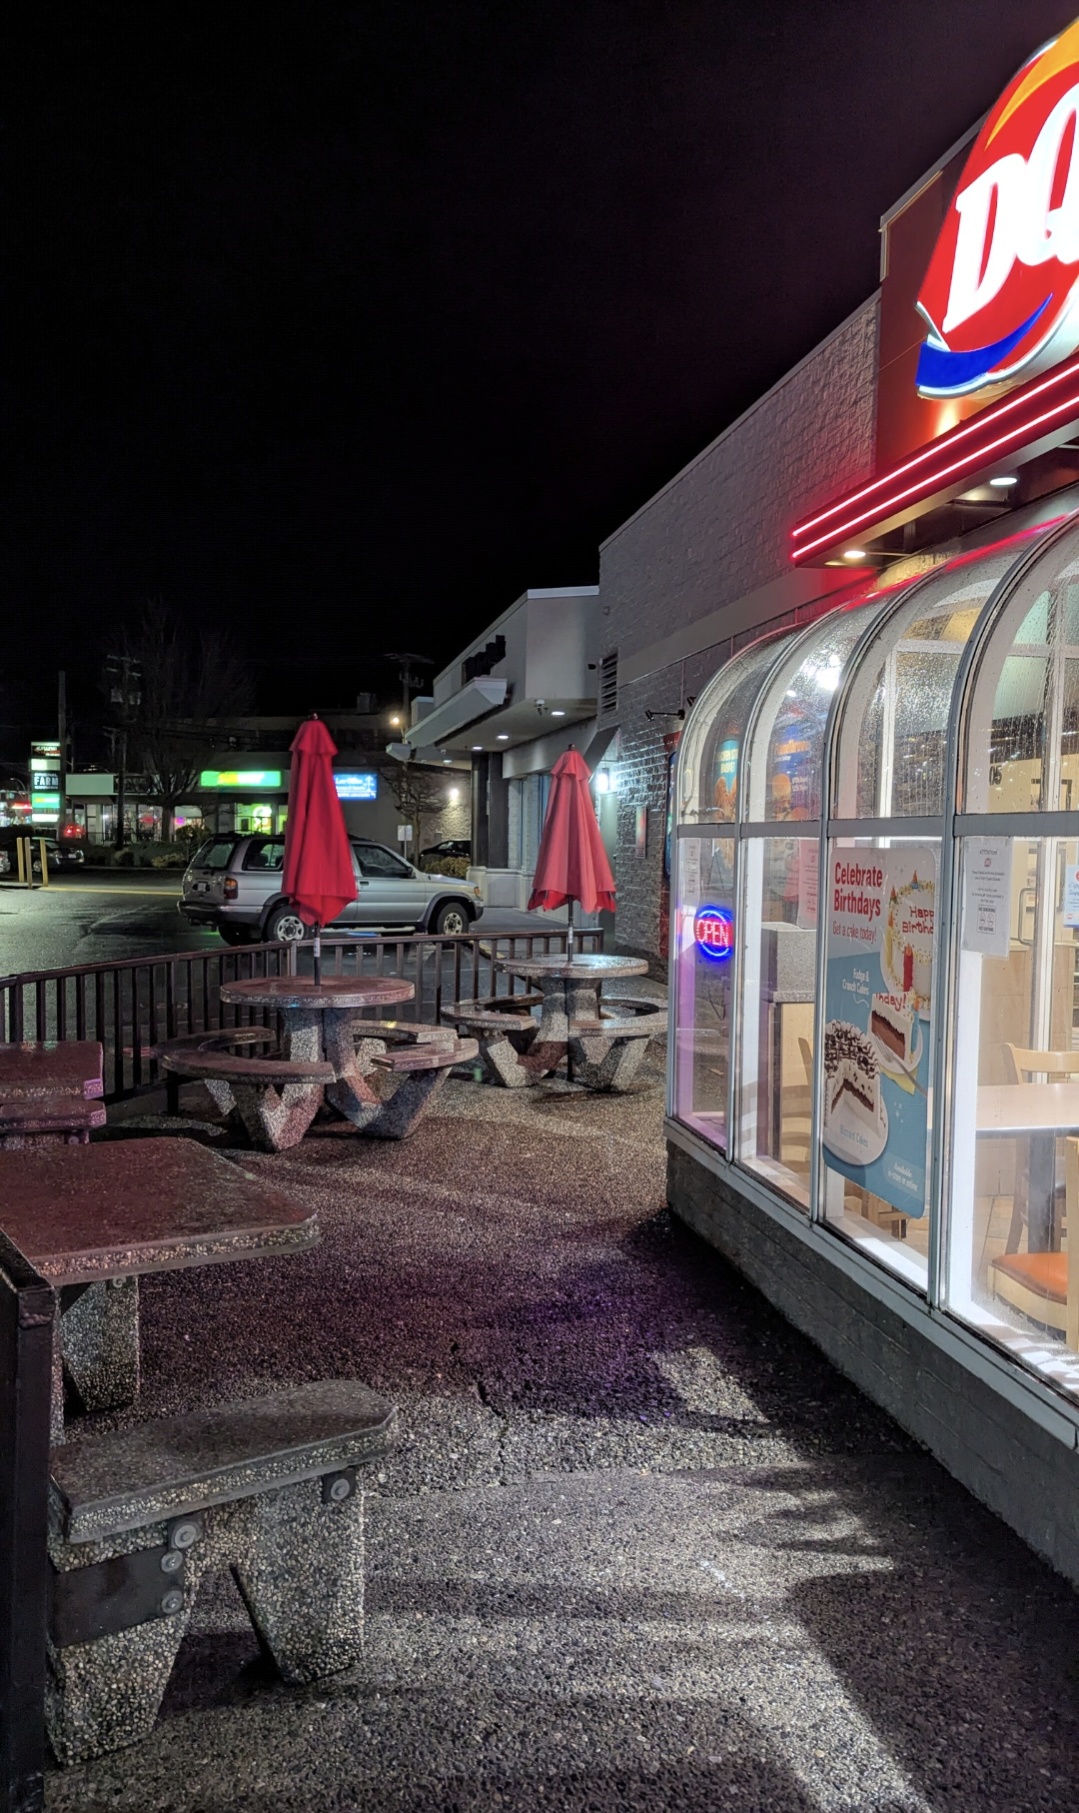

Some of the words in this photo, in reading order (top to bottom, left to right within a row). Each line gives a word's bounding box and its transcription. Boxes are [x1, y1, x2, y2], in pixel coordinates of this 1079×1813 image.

[942, 78, 1079, 334] DQ
[34, 776, 59, 786] FARM
[834, 862, 883, 888] Celebrate
[833, 887, 881, 922] Birthdays
[696, 918, 730, 948] OPEN
[832, 920, 842, 936] Get
[842, 925, 846, 937] a
[846, 923, 859, 938] cake
[860, 924, 876, 944] today!
